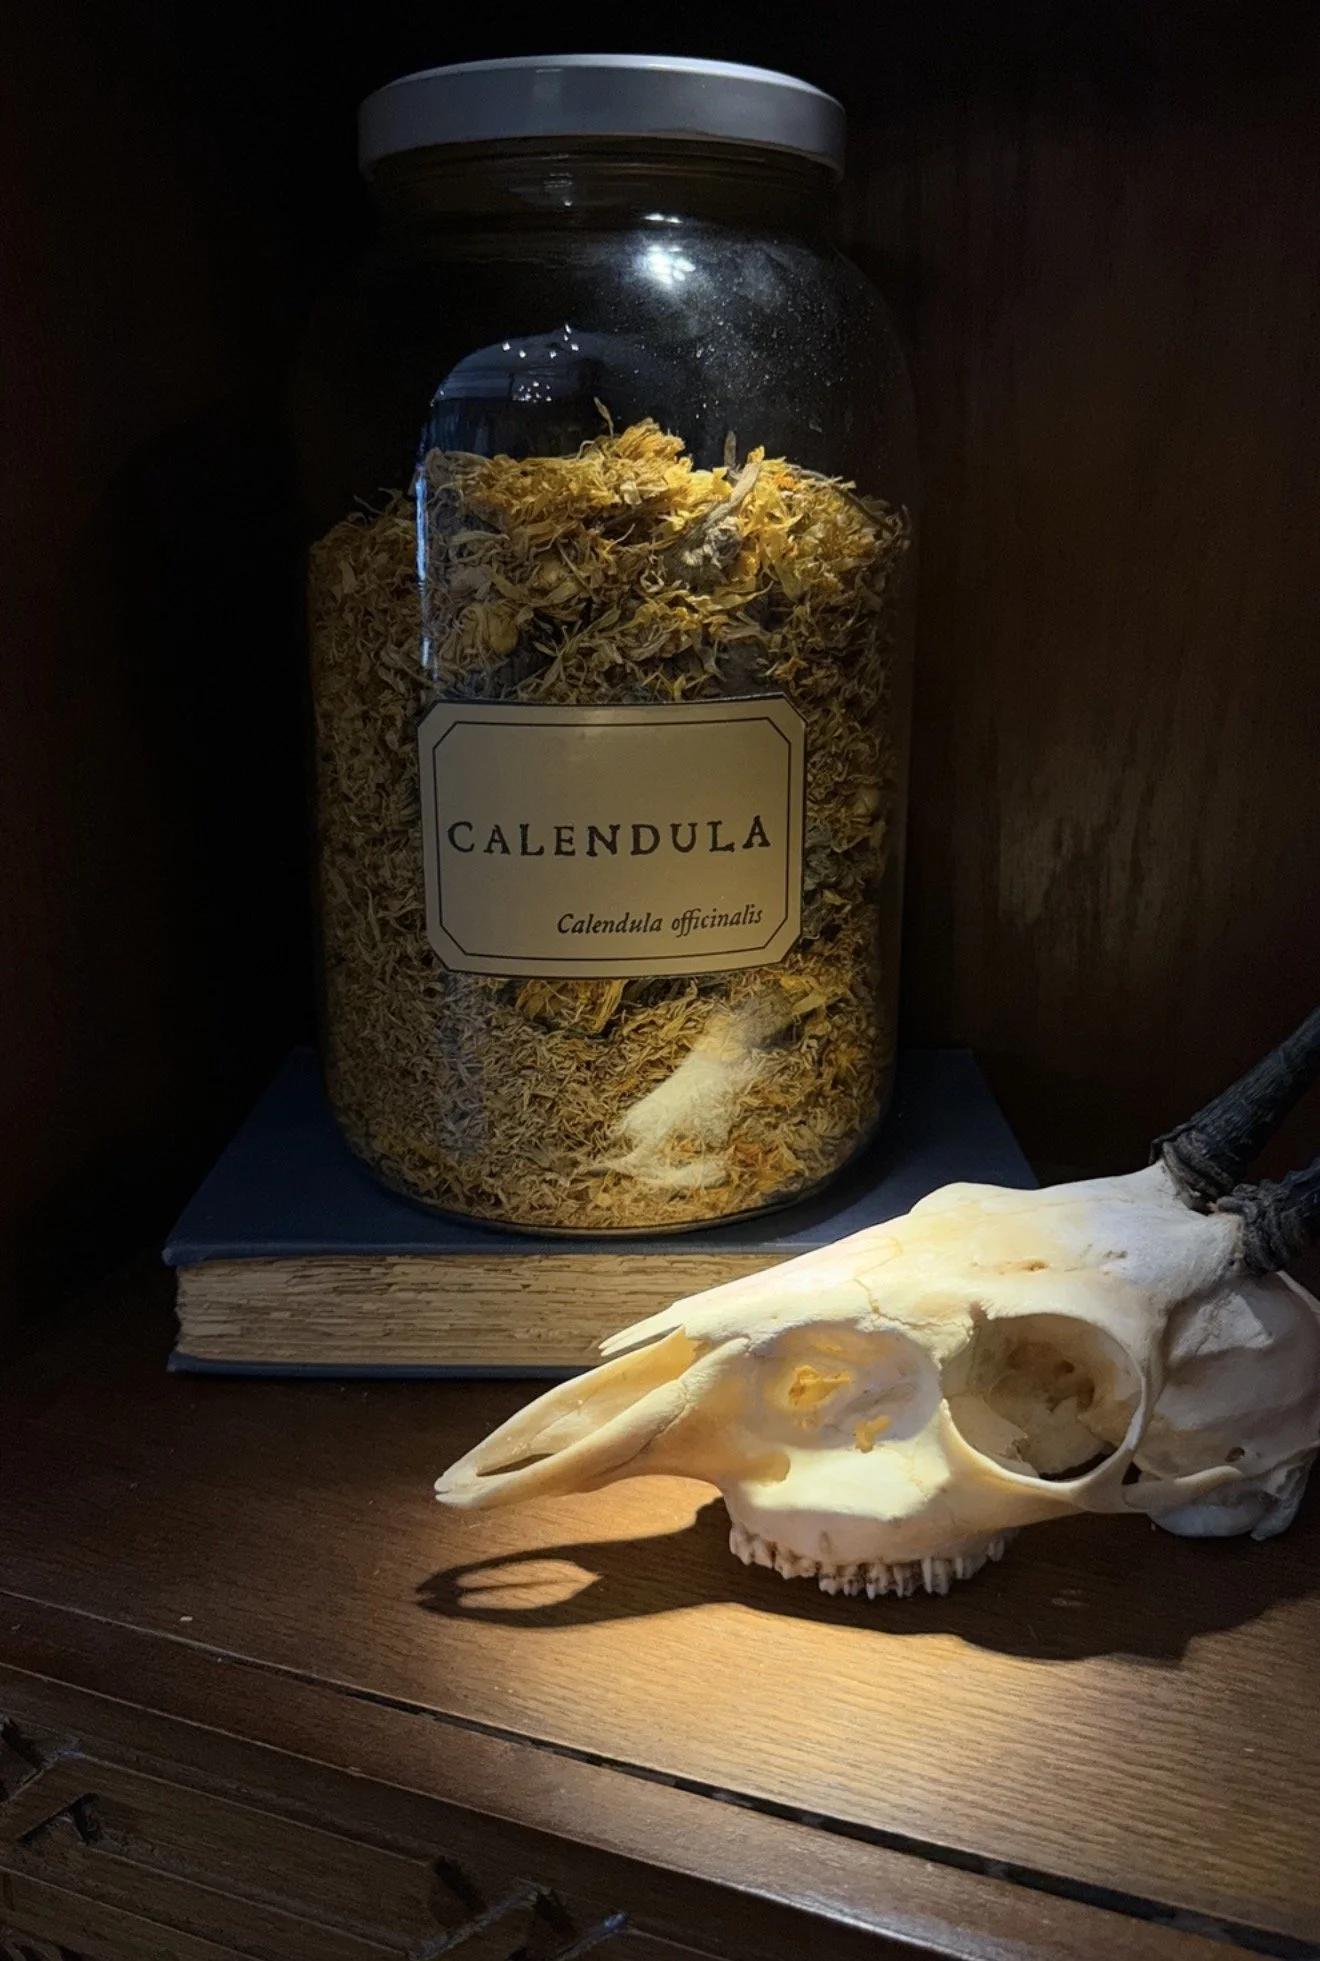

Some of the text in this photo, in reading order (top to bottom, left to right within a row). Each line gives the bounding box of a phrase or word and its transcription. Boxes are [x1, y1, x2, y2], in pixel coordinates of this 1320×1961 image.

[447, 815, 772, 857] CALENDULA
[556, 903, 764, 939] Calendula officinalis
